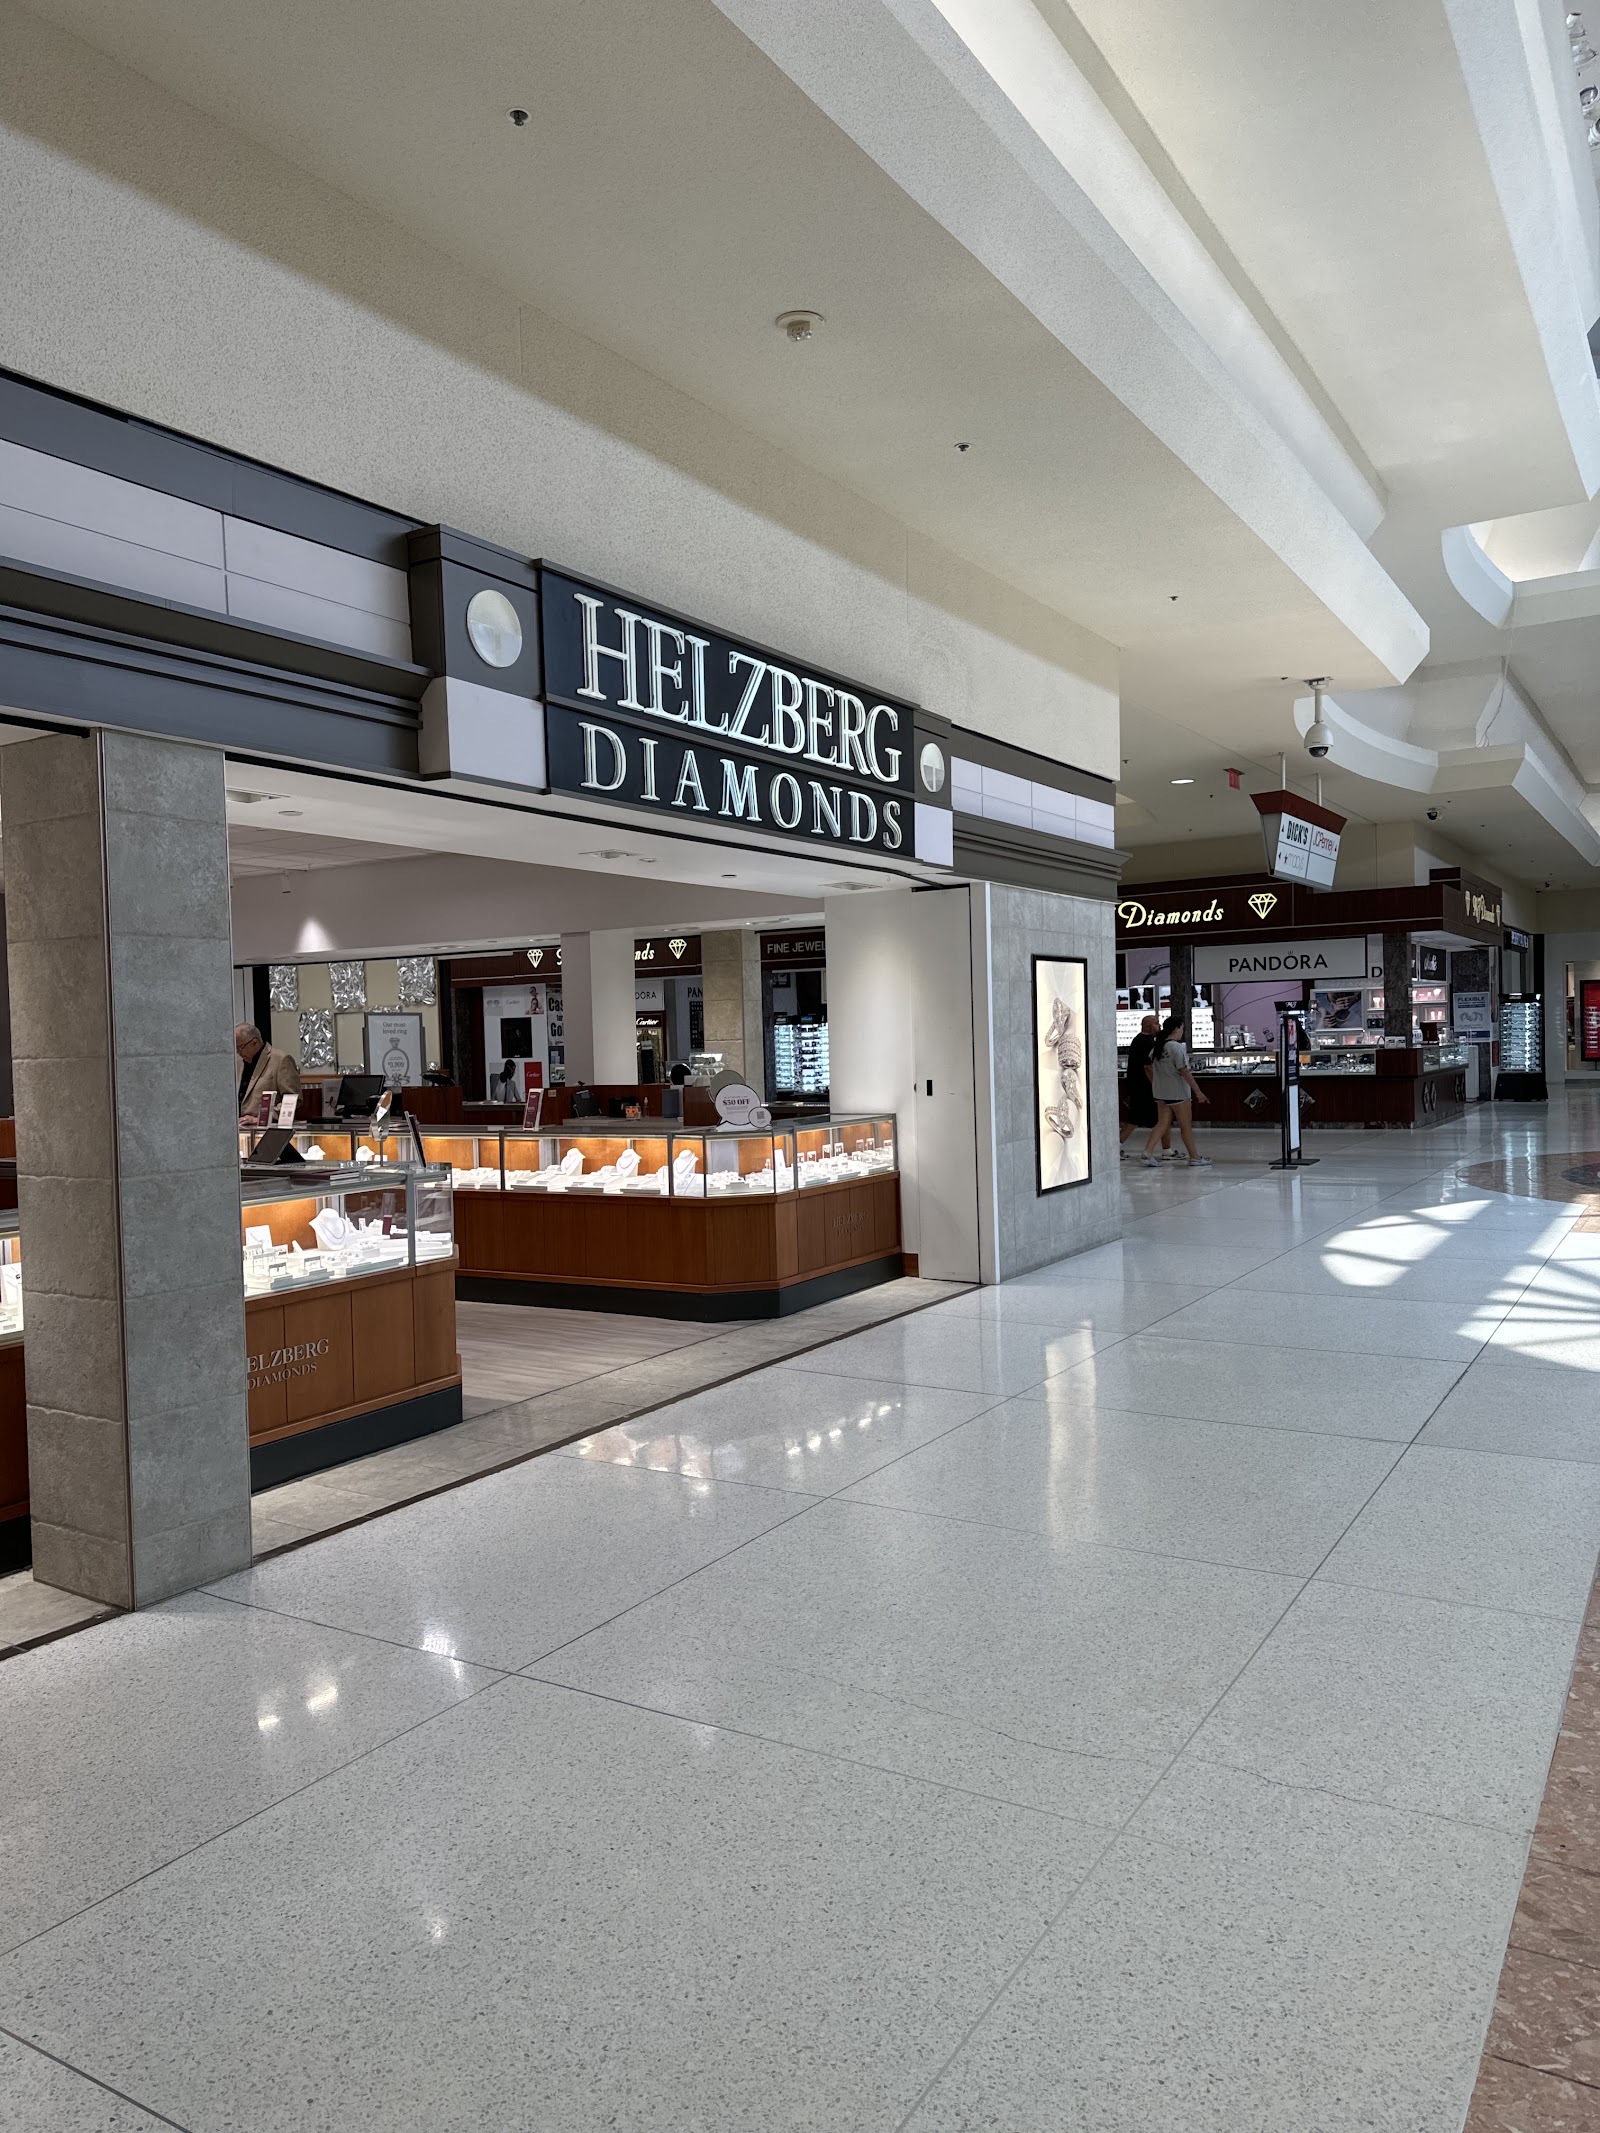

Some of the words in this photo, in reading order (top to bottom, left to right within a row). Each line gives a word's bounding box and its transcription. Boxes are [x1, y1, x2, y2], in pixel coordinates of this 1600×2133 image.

[574, 593, 902, 782] HELZBERG
[578, 722, 902, 849] DIAMONDS
[1286, 820, 1309, 845] DICK'S
[1117, 899, 1224, 928] Diamonds
[767, 942, 790, 954] FINE
[1229, 953, 1328, 972] PANDORA
[636, 1017, 659, 1026] Cartier
[737, 1098, 750, 1106] OFF
[247, 1362, 317, 1390] DIAMONDS
